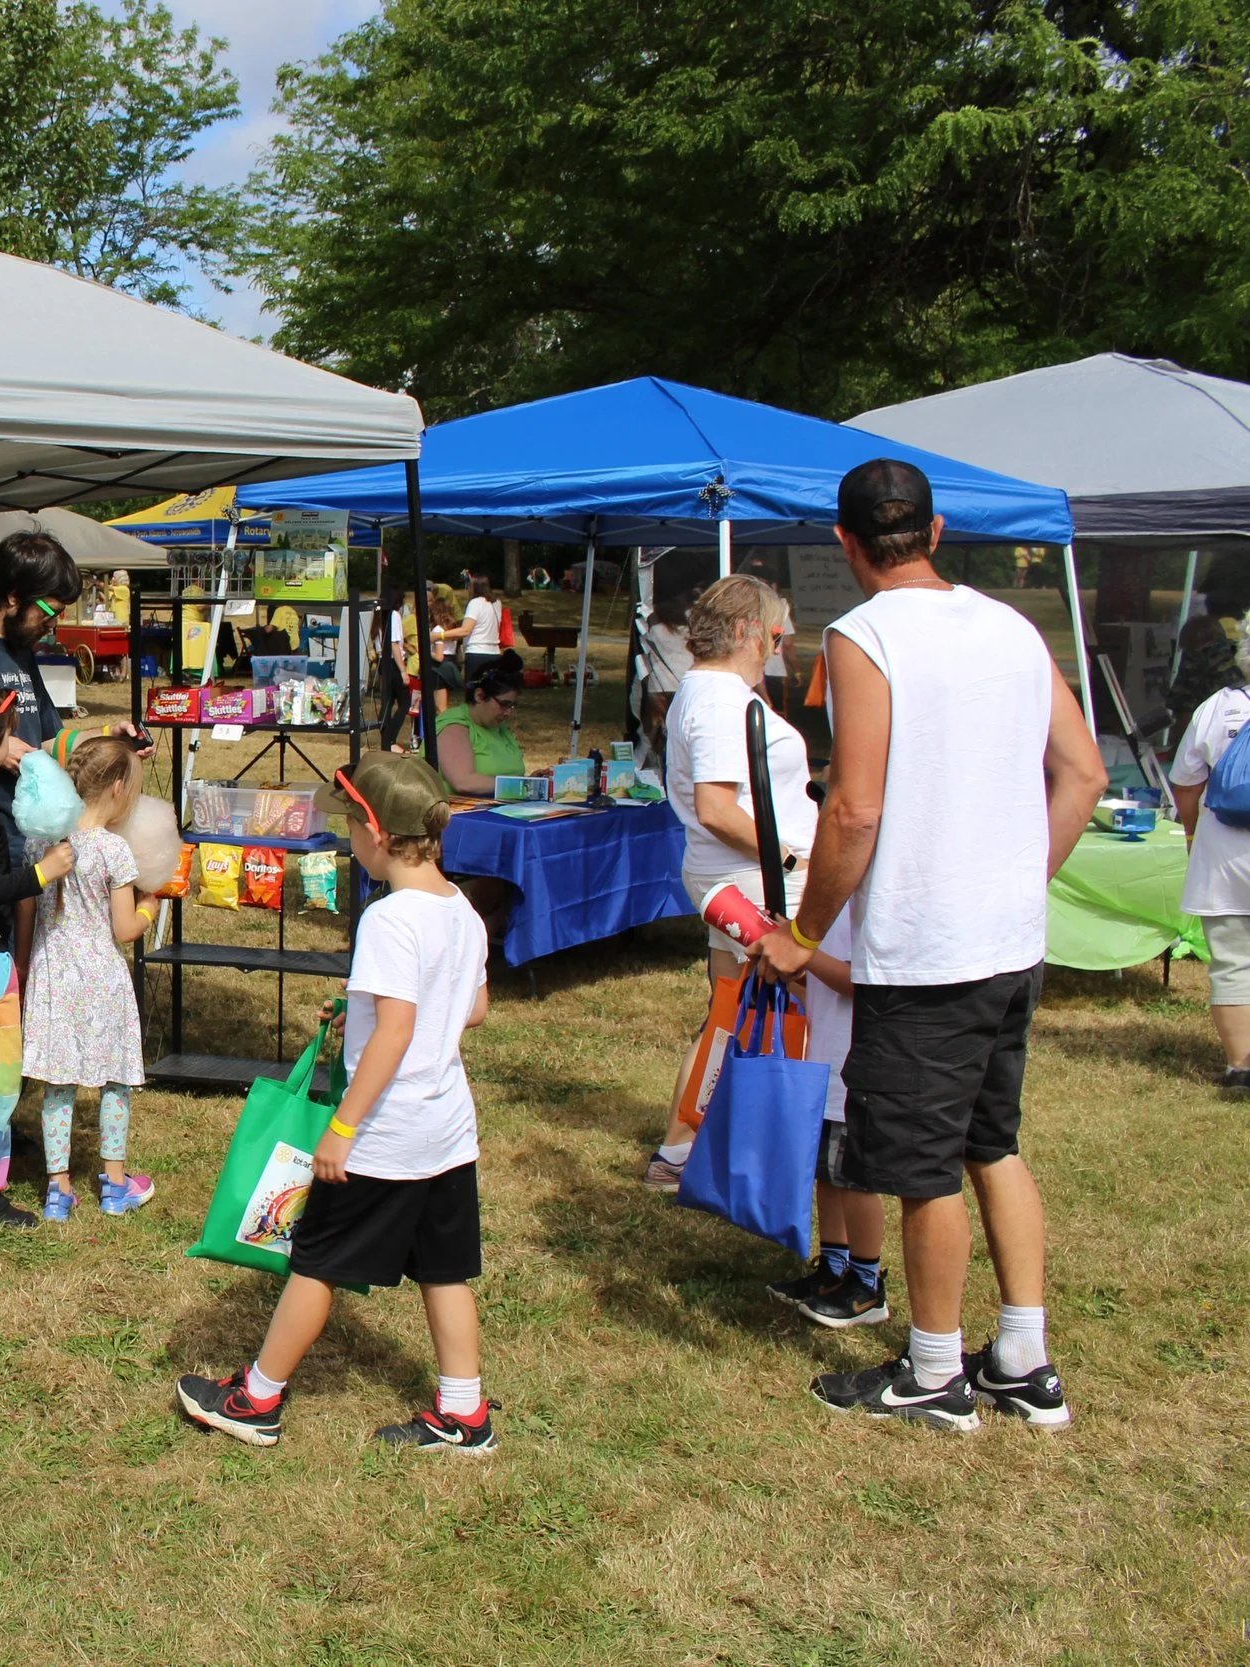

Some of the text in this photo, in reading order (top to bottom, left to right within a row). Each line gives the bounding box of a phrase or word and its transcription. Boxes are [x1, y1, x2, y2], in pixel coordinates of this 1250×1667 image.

[244, 526, 271, 536] Rotary
[156, 704, 187, 715] Skittles
[208, 705, 242, 716] Skittles
[245, 863, 280, 874] Doritos
